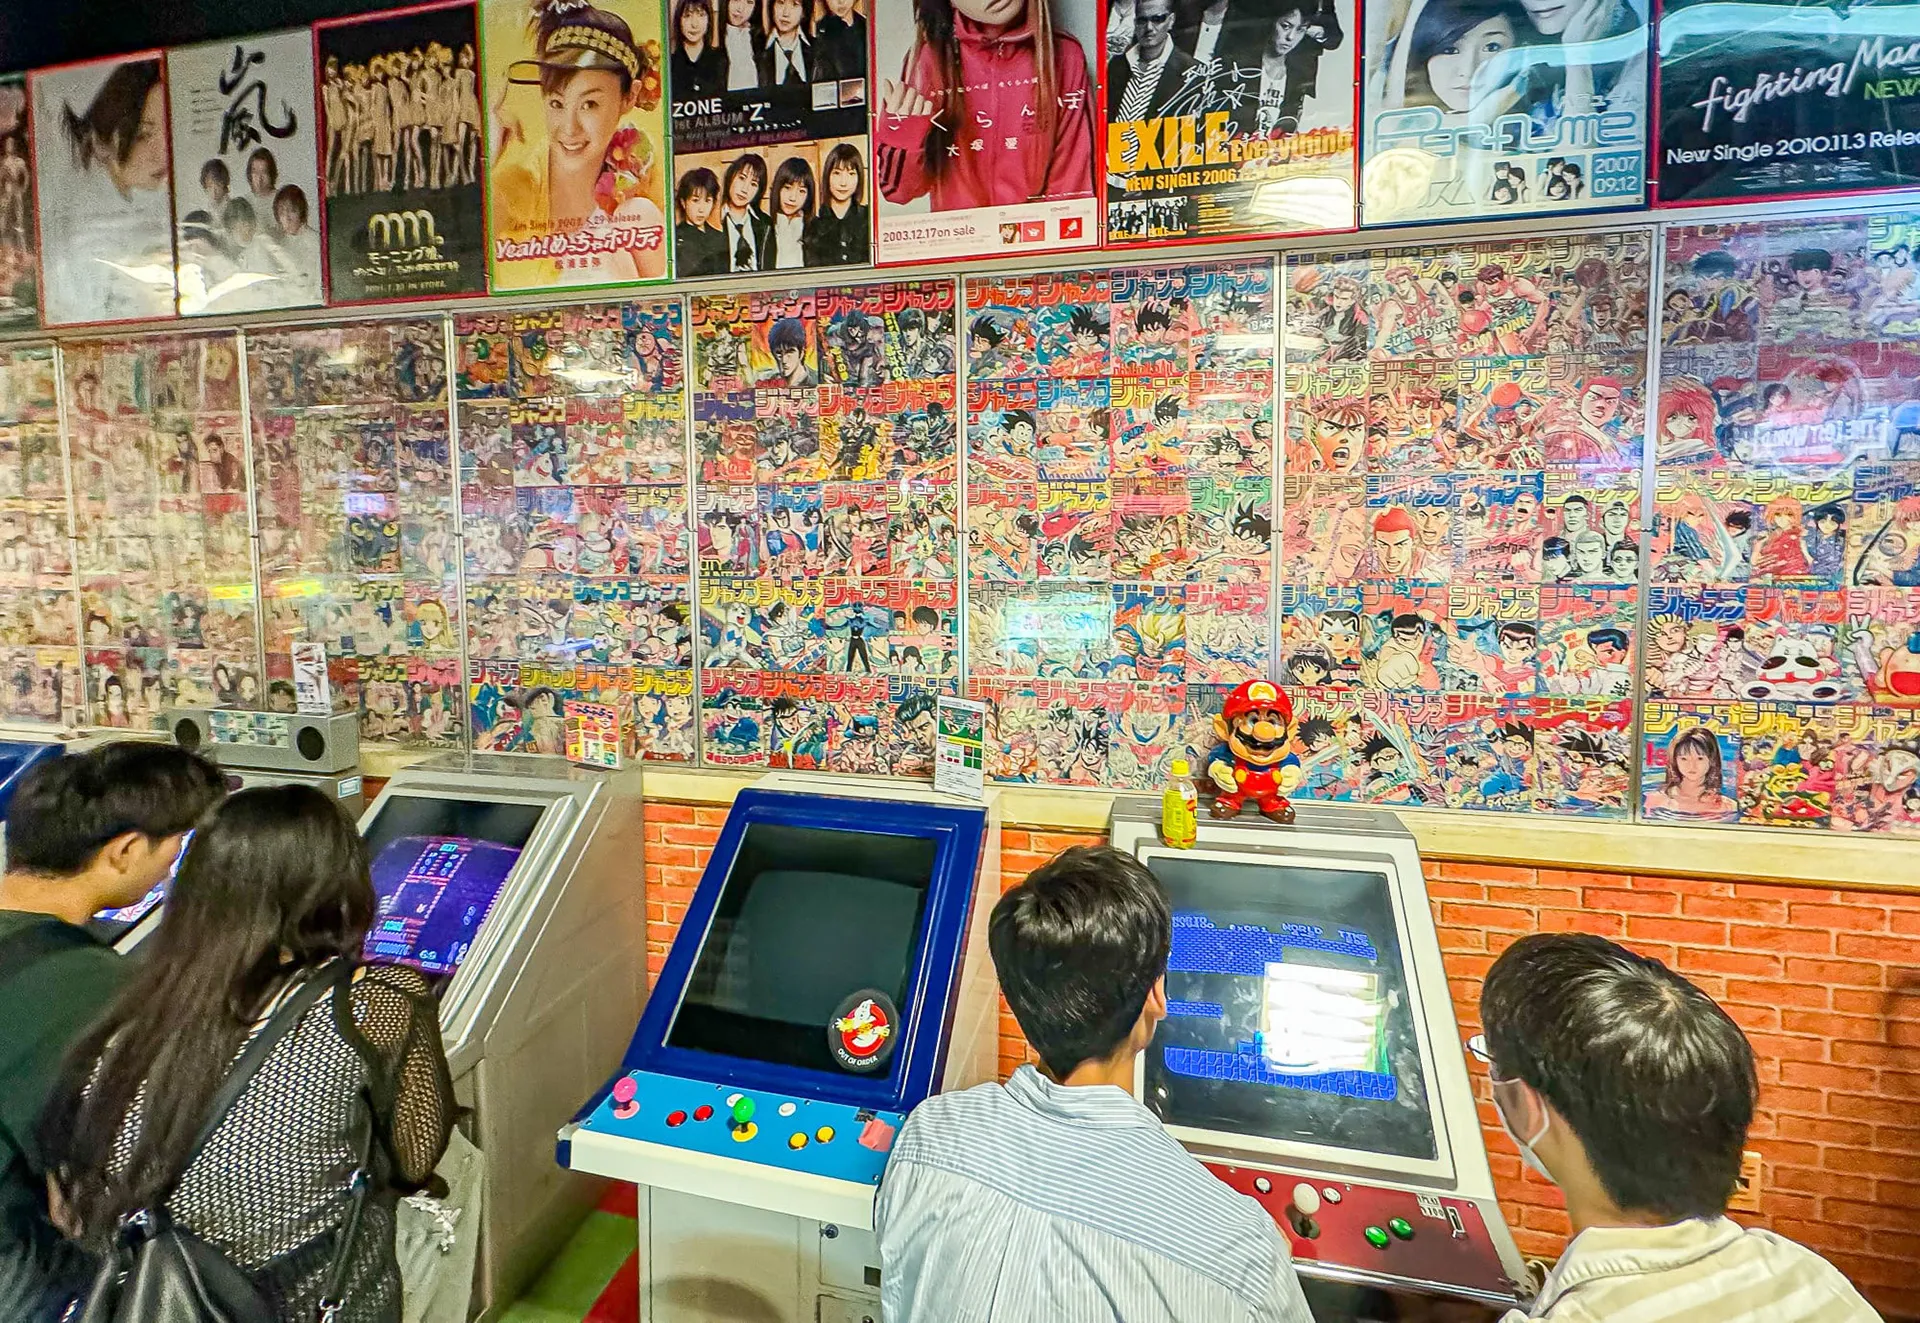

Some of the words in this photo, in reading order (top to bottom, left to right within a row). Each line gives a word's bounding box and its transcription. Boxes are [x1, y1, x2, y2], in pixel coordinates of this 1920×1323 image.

[672, 98, 722, 117] ZONE
[1692, 62, 1846, 133] fighting
[1108, 110, 1231, 173] EXILE
[1667, 148, 1711, 165] New
[1713, 144, 1774, 161] Single
[1775, 134, 1866, 157] 2010.11.3
[1595, 157, 1639, 174] 2007
[1126, 175, 1154, 193] NEW
[1156, 170, 1202, 191] SINGLE
[1595, 176, 1639, 193] 09.12
[953, 224, 976, 237] sale
